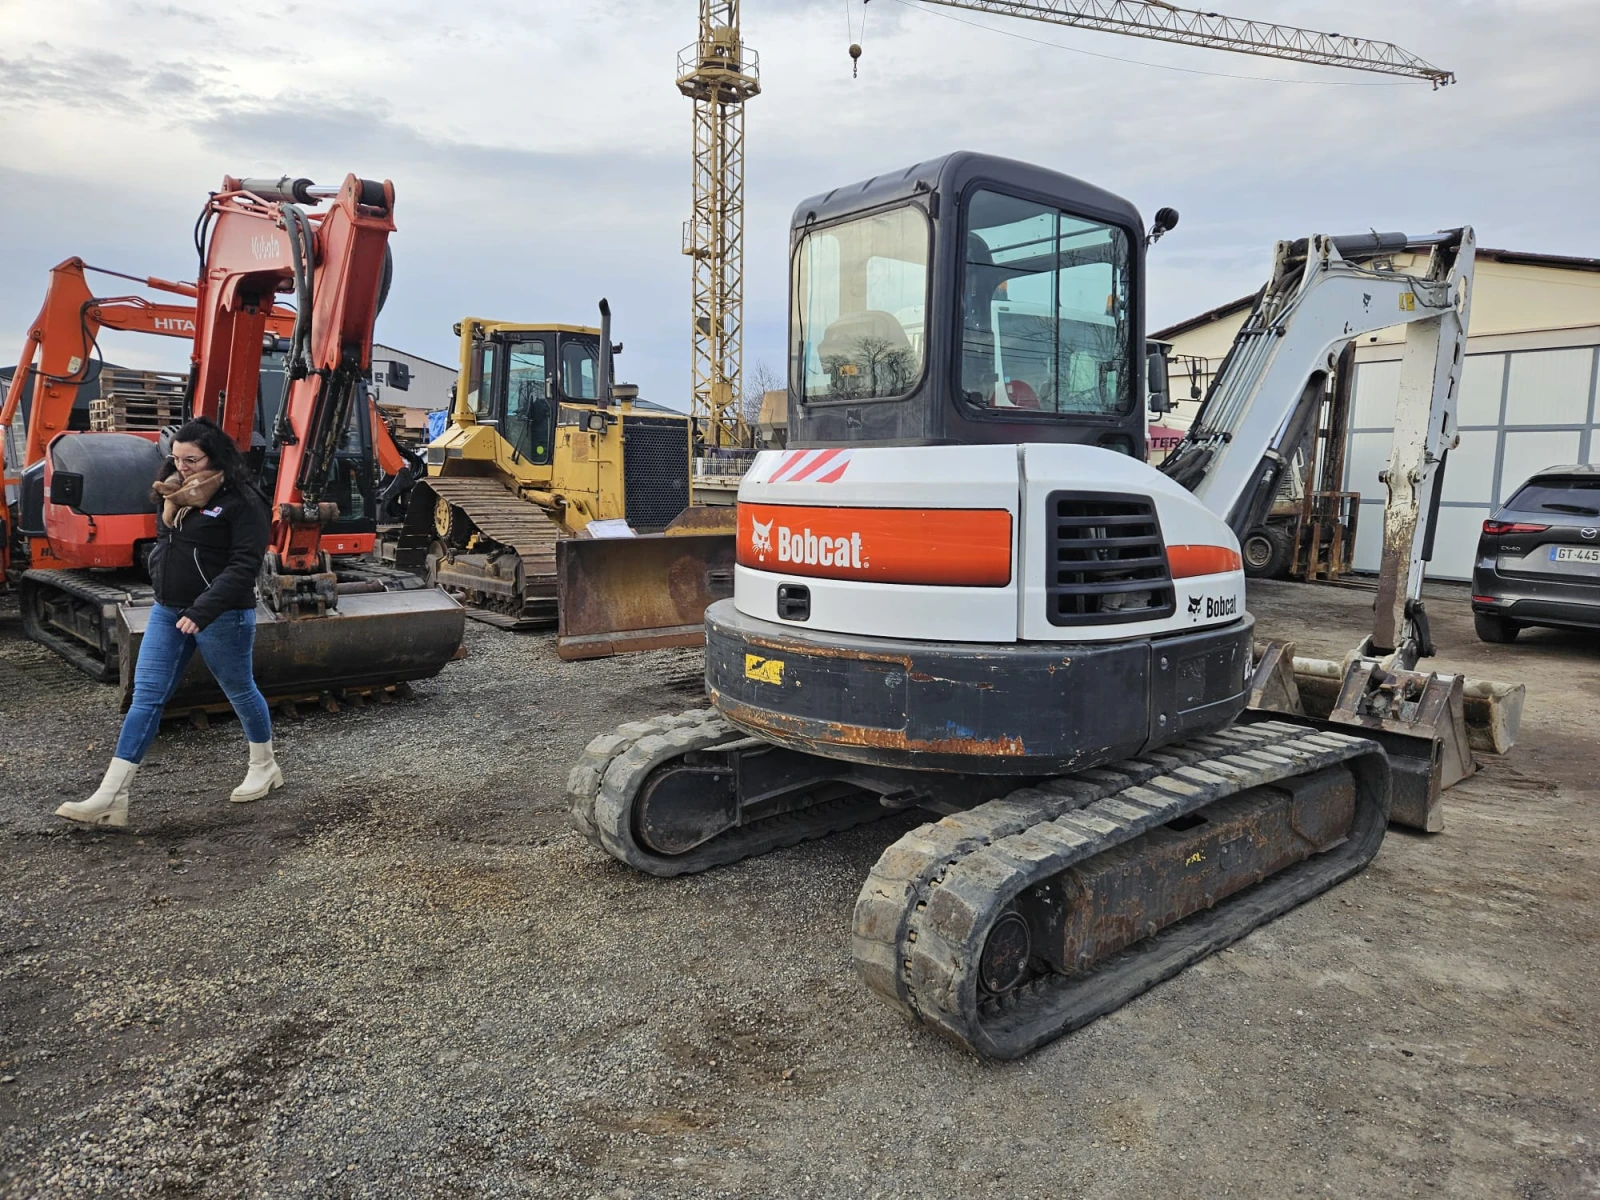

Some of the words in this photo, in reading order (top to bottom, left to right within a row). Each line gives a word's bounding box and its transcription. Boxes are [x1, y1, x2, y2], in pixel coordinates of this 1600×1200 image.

[251, 232, 280, 260] Kubota
[154, 317, 196, 331] HITA
[778, 526, 862, 568] Bobcat
[1206, 594, 1236, 618] Bobcat
